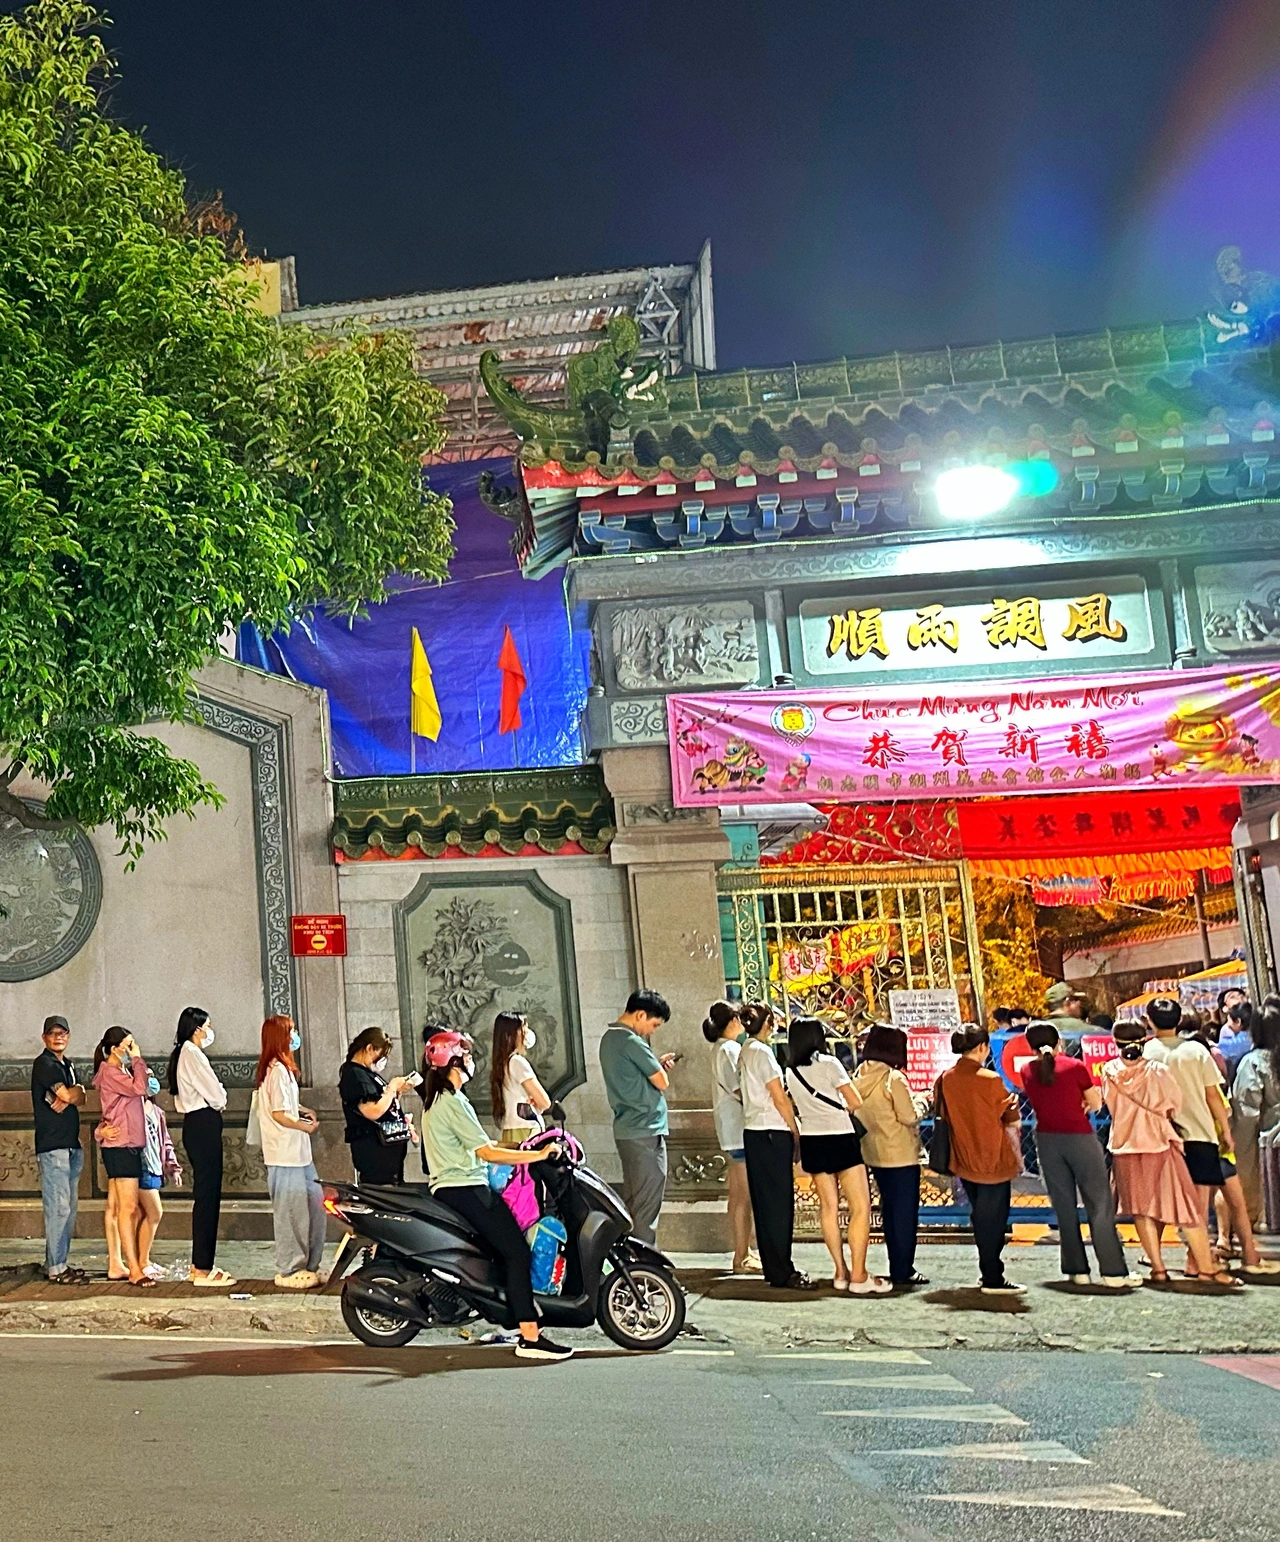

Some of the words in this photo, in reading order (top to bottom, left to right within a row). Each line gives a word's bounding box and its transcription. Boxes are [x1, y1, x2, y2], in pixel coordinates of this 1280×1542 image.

[823, 699, 908, 722] Chúc
[918, 695, 1002, 723] Mừng
[1080, 687, 1142, 710] Mới
[862, 719, 1114, 770] 恭賀新禧
[907, 1037, 930, 1051] LƯU
